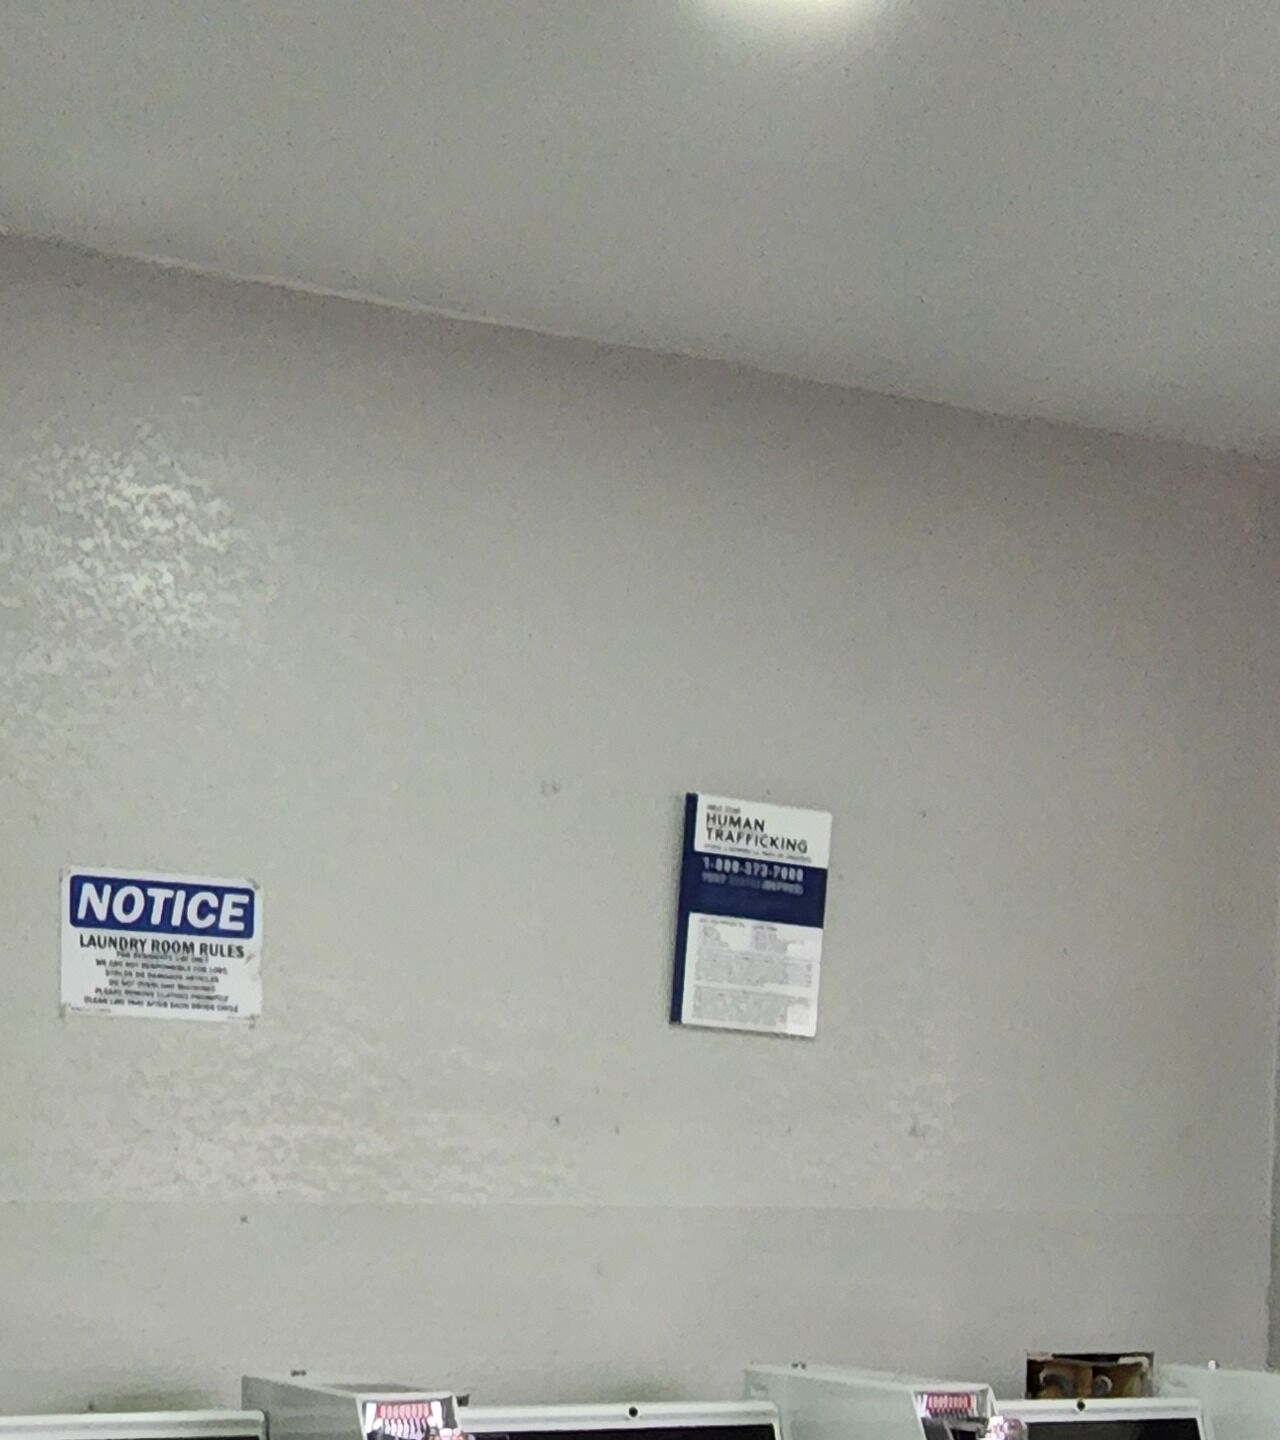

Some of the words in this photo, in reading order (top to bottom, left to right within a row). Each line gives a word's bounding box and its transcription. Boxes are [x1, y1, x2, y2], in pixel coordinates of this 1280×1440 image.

[706, 813, 766, 833] HUMAN
[706, 827, 809, 854] TRAFFICKING
[77, 882, 250, 932] NOTICE
[80, 934, 147, 953] LAUNDRY
[151, 939, 195, 955] ROOM
[200, 943, 245, 959] RULES
